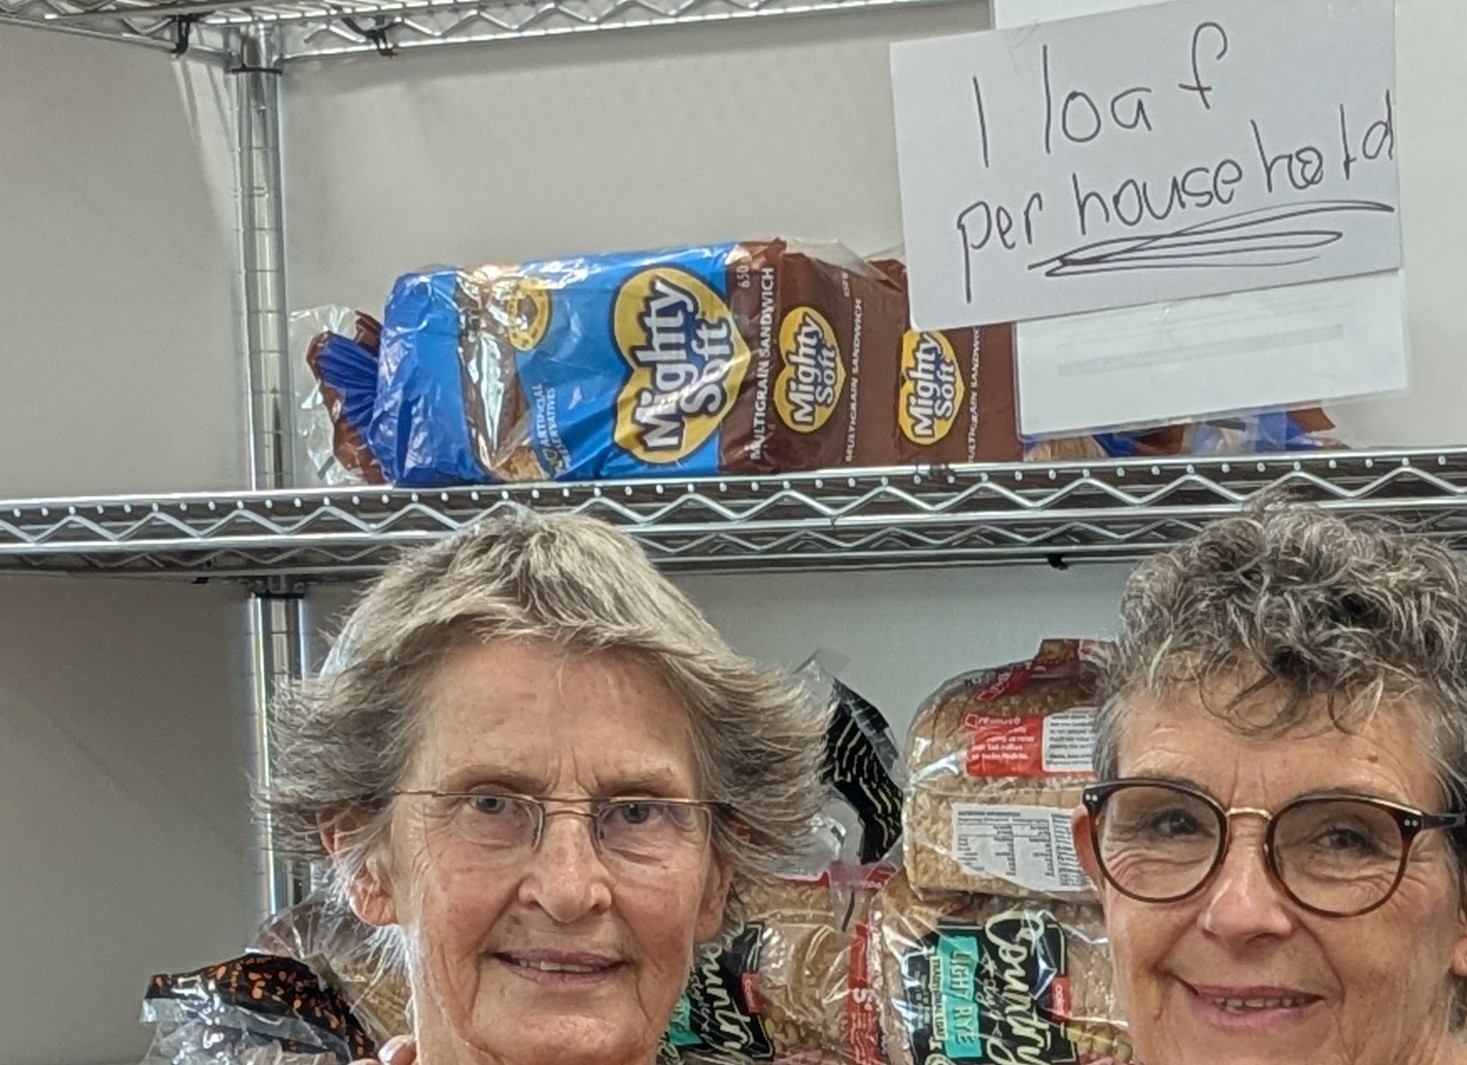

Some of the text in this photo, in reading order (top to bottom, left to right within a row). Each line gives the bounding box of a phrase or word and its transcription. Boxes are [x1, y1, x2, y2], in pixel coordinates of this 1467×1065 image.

[1043, 22, 1229, 154] loaf
[956, 89, 1395, 303] per household
[633, 279, 698, 449] Mighty
[679, 320, 734, 414] Soft
[749, 266, 775, 461] MULTIGRAIN SANDWICH
[787, 313, 822, 424] Mighty
[815, 344, 836, 405] Soft
[845, 297, 862, 462] MULTIGRAIN SANDWICH
[907, 331, 942, 437] Mighty
[934, 361, 954, 420] Soft
[950, 948, 977, 1046] LIGHT RYE
